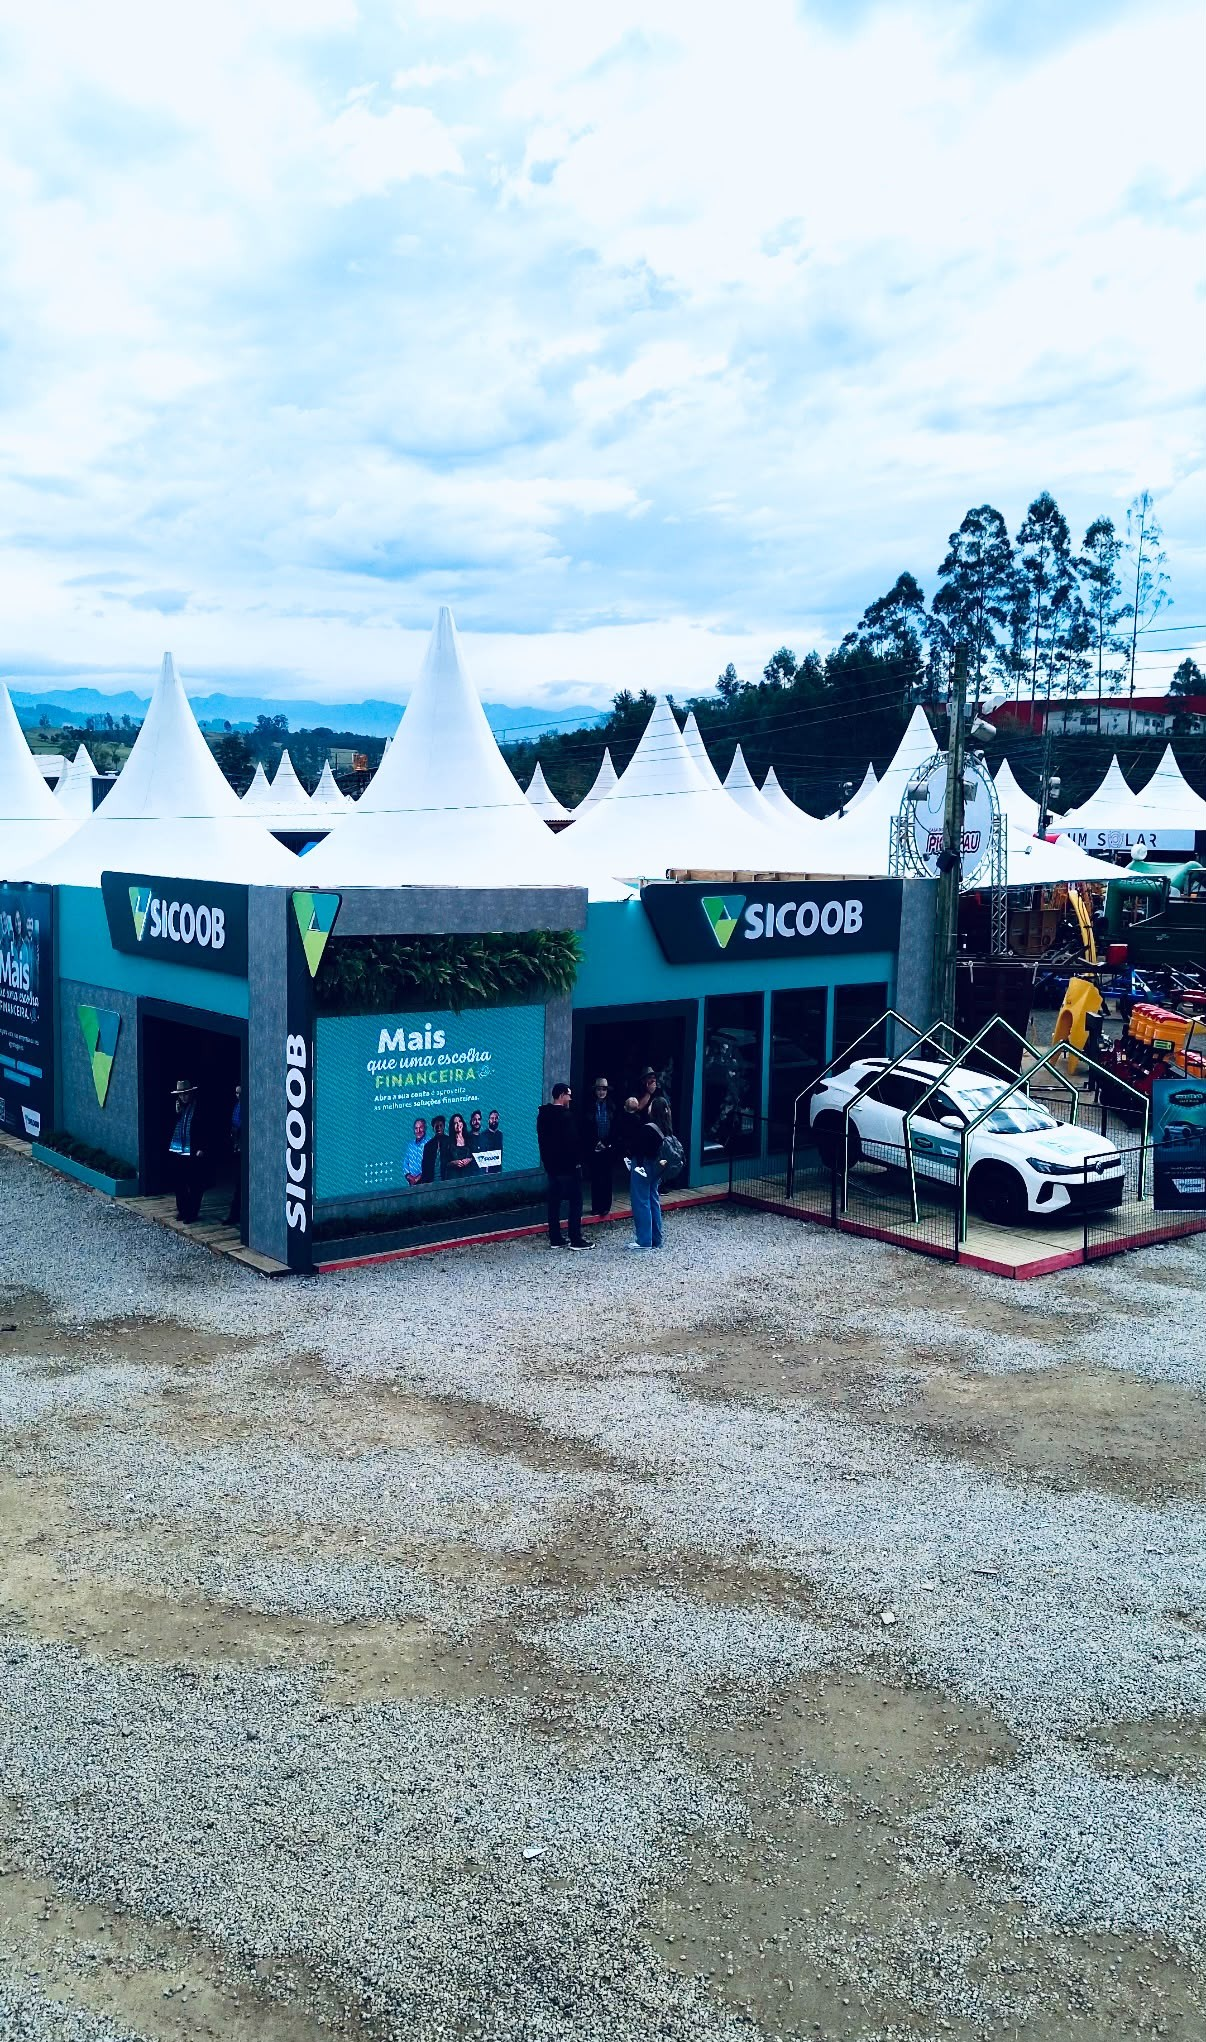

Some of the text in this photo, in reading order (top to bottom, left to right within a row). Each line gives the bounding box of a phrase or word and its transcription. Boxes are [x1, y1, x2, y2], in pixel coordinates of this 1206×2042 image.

[150, 899, 225, 949] SICOOB
[745, 899, 863, 940] SICOOB
[0, 950, 30, 990] Mais
[378, 1023, 446, 1053] Mais
[367, 1048, 492, 1075] que uma escolha
[375, 1067, 476, 1088] FINANCEIRA
[374, 1094, 391, 1102] Abra
[286, 1034, 306, 1233] SICOOB
